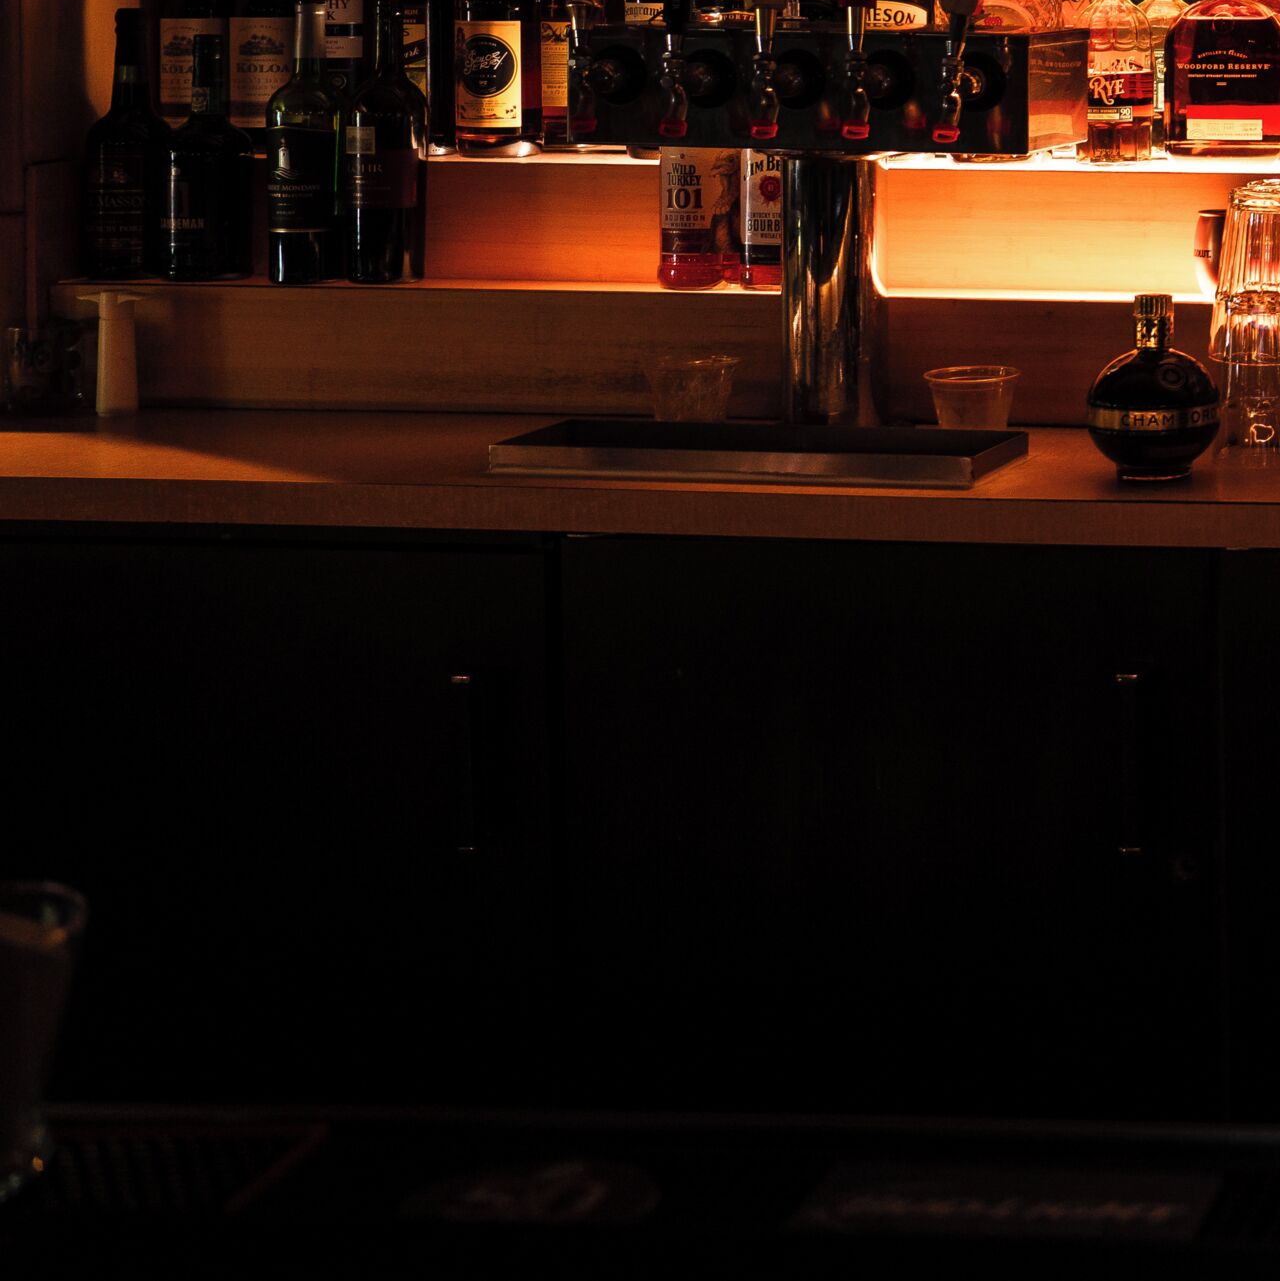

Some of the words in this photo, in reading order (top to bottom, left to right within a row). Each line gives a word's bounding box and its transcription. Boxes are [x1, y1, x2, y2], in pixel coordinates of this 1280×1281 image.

[236, 62, 292, 74] KOLOA
[1176, 62, 1226, 71] WOODFORD
[1227, 62, 1270, 71] RESERVE
[1088, 76, 1126, 105] RYE
[1119, 107, 1132, 117] 90
[671, 163, 697, 176] WILD
[666, 173, 703, 187] TURKEY
[665, 188, 704, 210] 101
[664, 214, 706, 222] BOURBON
[747, 218, 782, 233] BOURB
